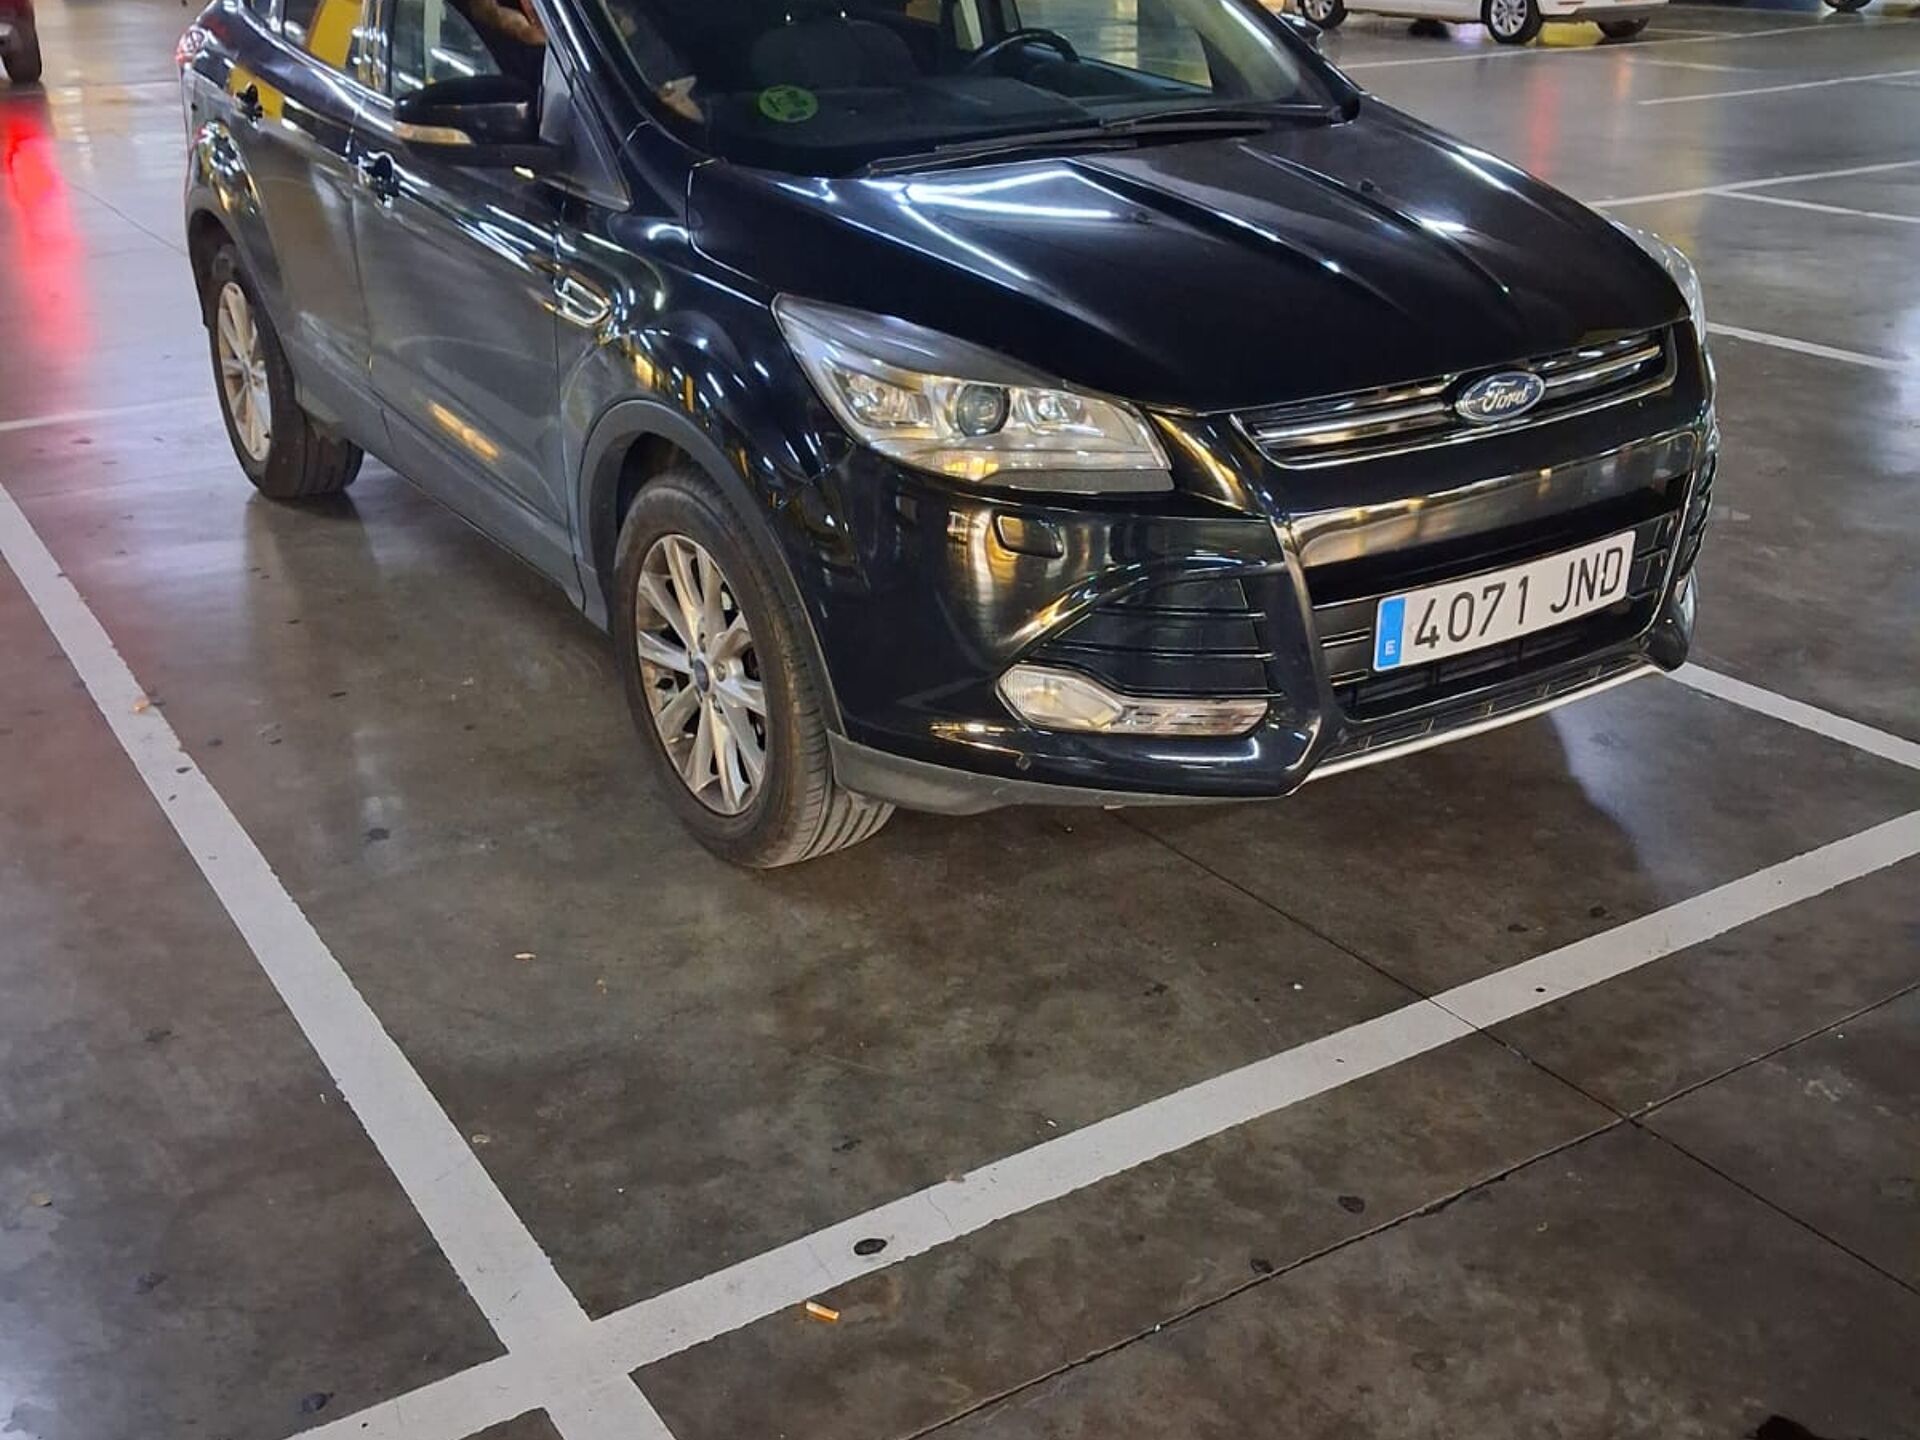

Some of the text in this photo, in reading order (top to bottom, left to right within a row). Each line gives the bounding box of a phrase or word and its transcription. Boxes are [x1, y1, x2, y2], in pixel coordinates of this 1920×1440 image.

[1477, 380, 1533, 412] Ford
[1414, 546, 1624, 649] 4071 JND
[1384, 640, 1396, 656] E
